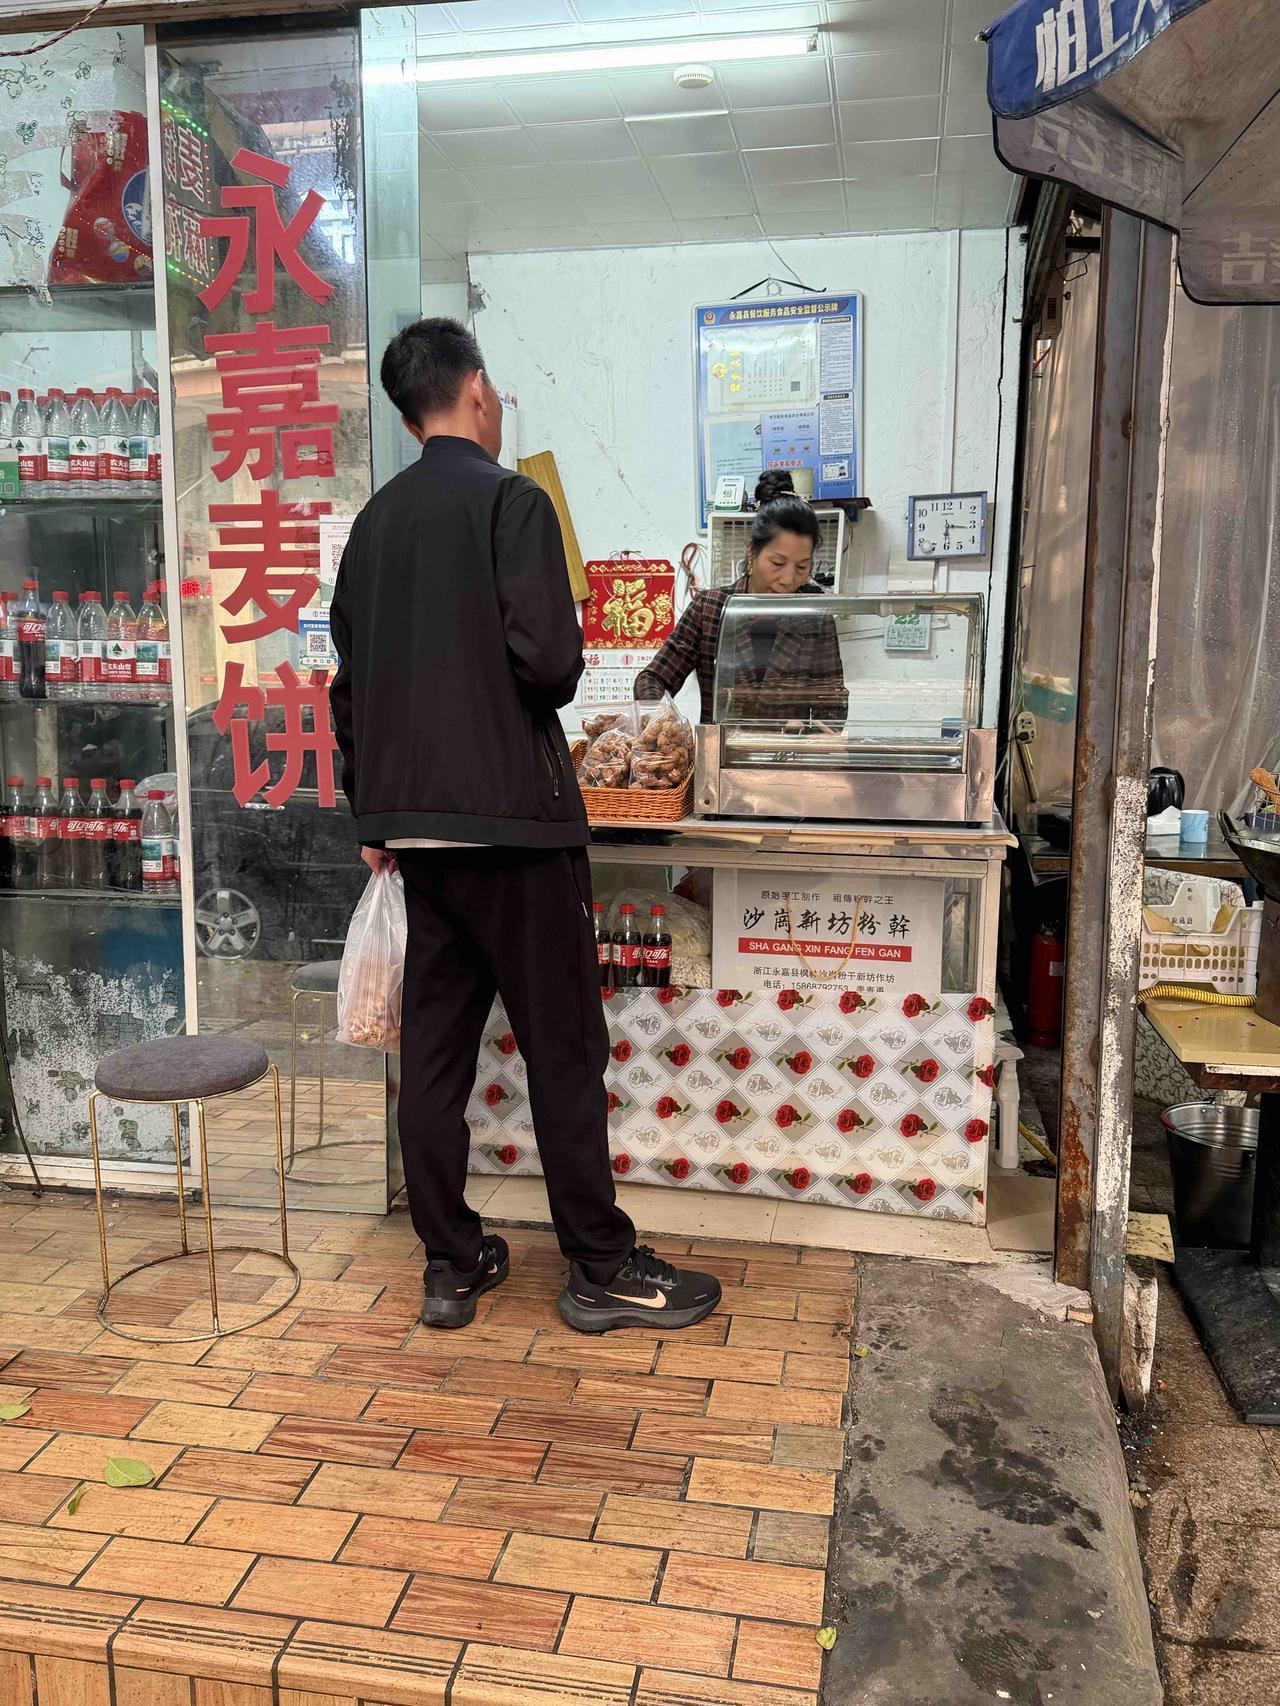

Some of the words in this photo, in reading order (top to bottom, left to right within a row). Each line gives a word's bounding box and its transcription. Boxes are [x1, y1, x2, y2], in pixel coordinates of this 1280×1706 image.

[197, 147, 341, 809] 永嘉麦饼
[931, 502, 939, 511] 11
[942, 501, 953, 511] 12
[958, 501, 963, 510] 1
[918, 508, 928, 517] 10
[969, 506, 977, 515] 2
[918, 523, 926, 532] 9
[969, 520, 976, 529] 3
[968, 535, 975, 544] 4
[943, 541, 950, 551] 6
[956, 541, 963, 550] 5
[761, 890, 821, 902] 原始手工制作
[748, 941, 770, 952] SHA
[772, 942, 802, 954] GANG
[805, 944, 821, 955] XIN
[824, 945, 853, 956] FANG
[855, 946, 875, 957] FEN
[879, 947, 901, 959] GAN
